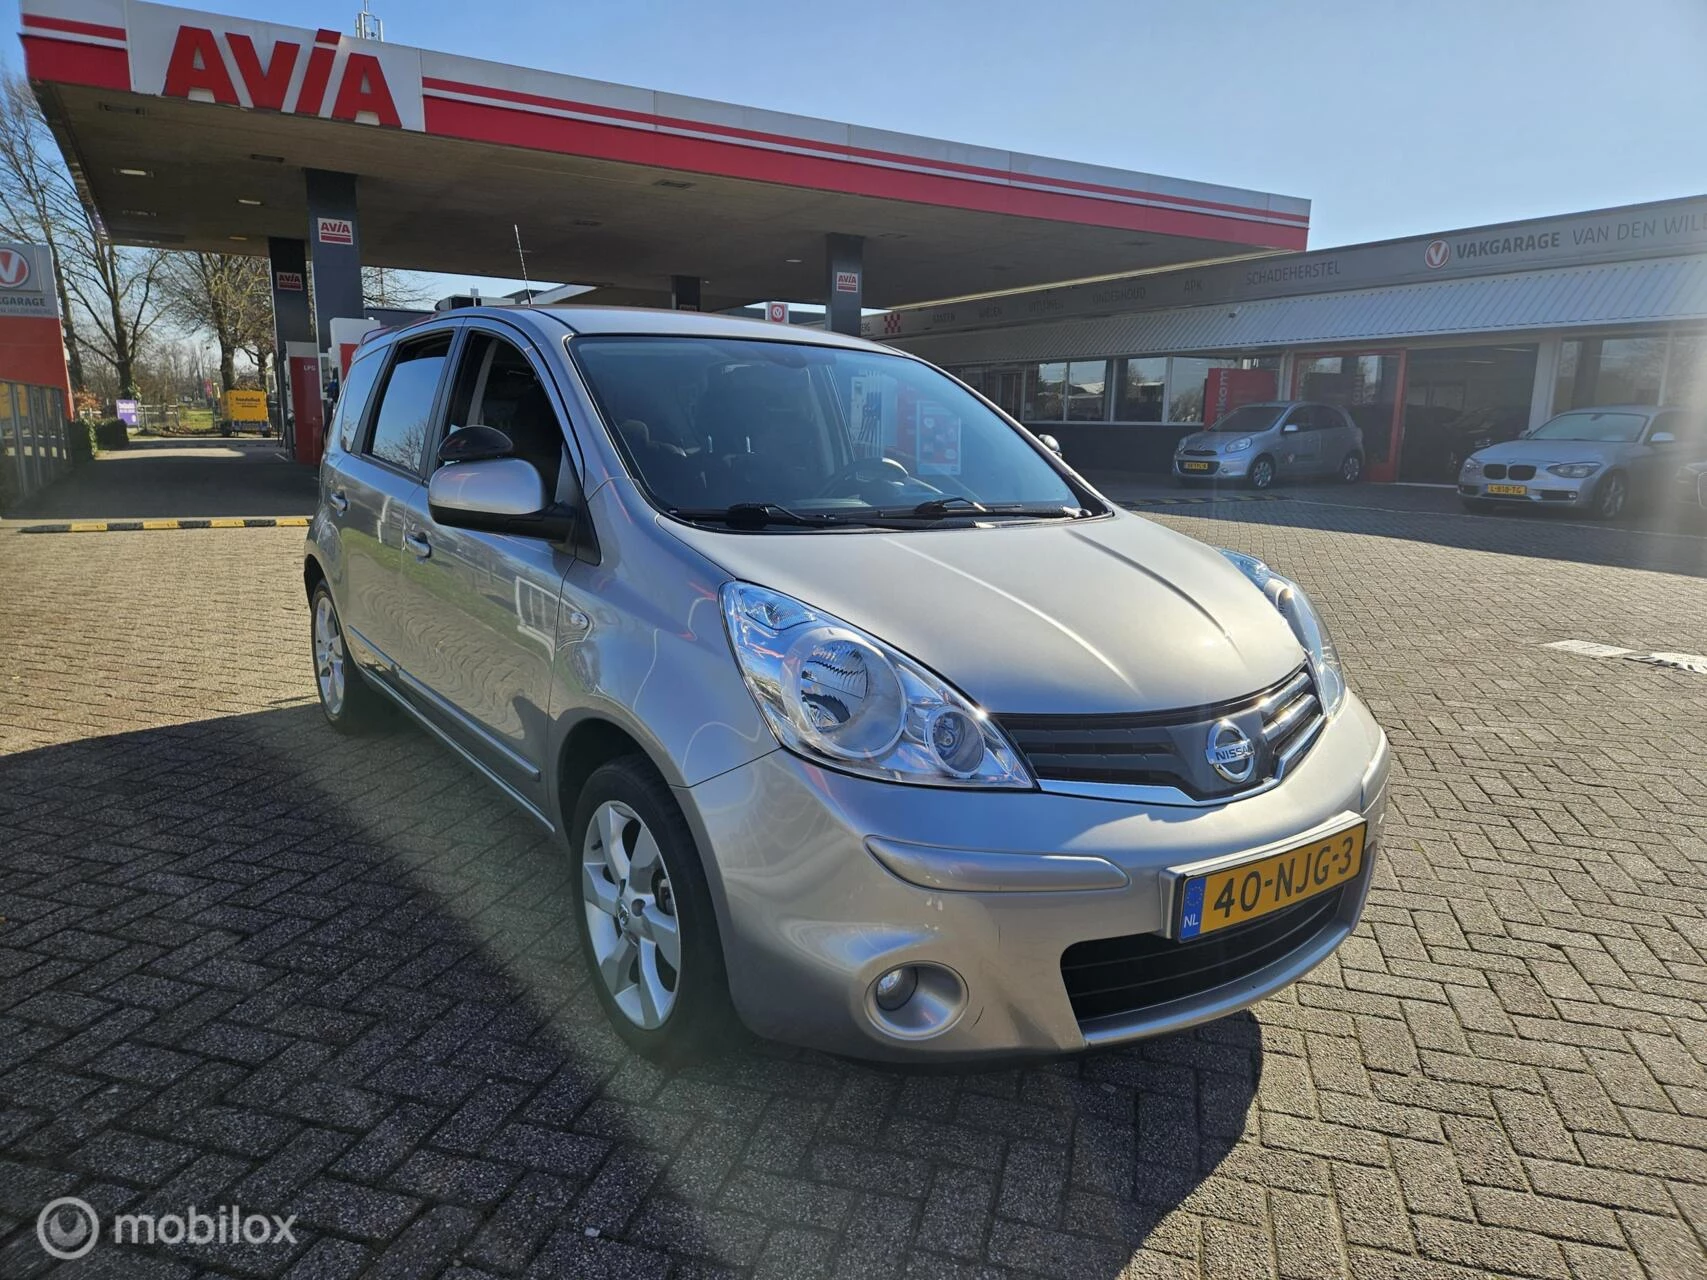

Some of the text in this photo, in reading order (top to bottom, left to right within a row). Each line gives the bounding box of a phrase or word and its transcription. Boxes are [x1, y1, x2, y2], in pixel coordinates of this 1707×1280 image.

[1456, 232, 1560, 259] VAKGARAGE
[1573, 226, 1609, 246] VAN
[1617, 219, 1656, 241] DEN
[1664, 212, 1707, 235] WIL
[1246, 259, 1341, 286] SCHADEHERSTEL
[0, 296, 46, 307] GARAGE
[1184, 836, 1354, 928] NL 40-NJG-3
